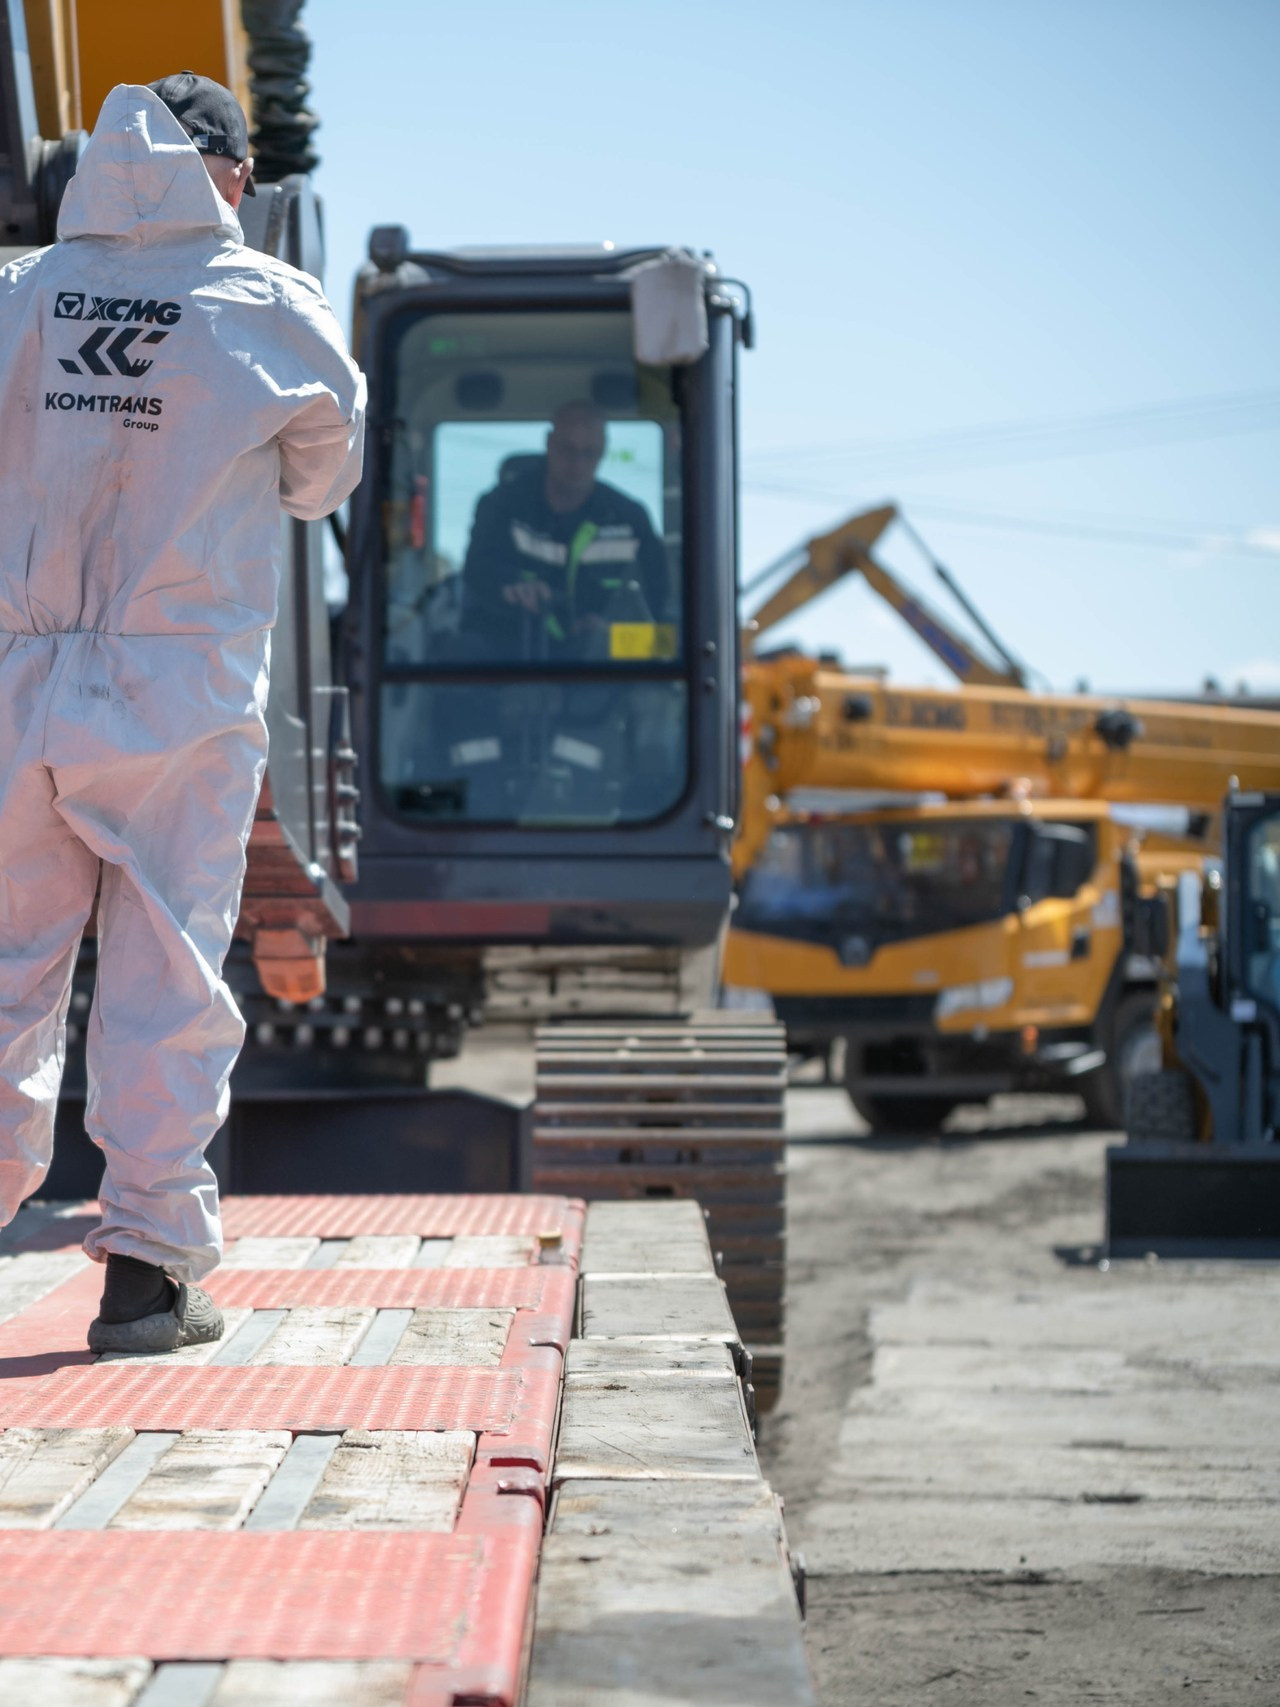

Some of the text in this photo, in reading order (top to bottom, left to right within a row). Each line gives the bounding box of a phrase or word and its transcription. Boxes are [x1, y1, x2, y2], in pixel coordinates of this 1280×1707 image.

[82, 296, 182, 326] XCMG
[45, 392, 163, 416] KOMTRANS
[123, 418, 159, 432] Group
